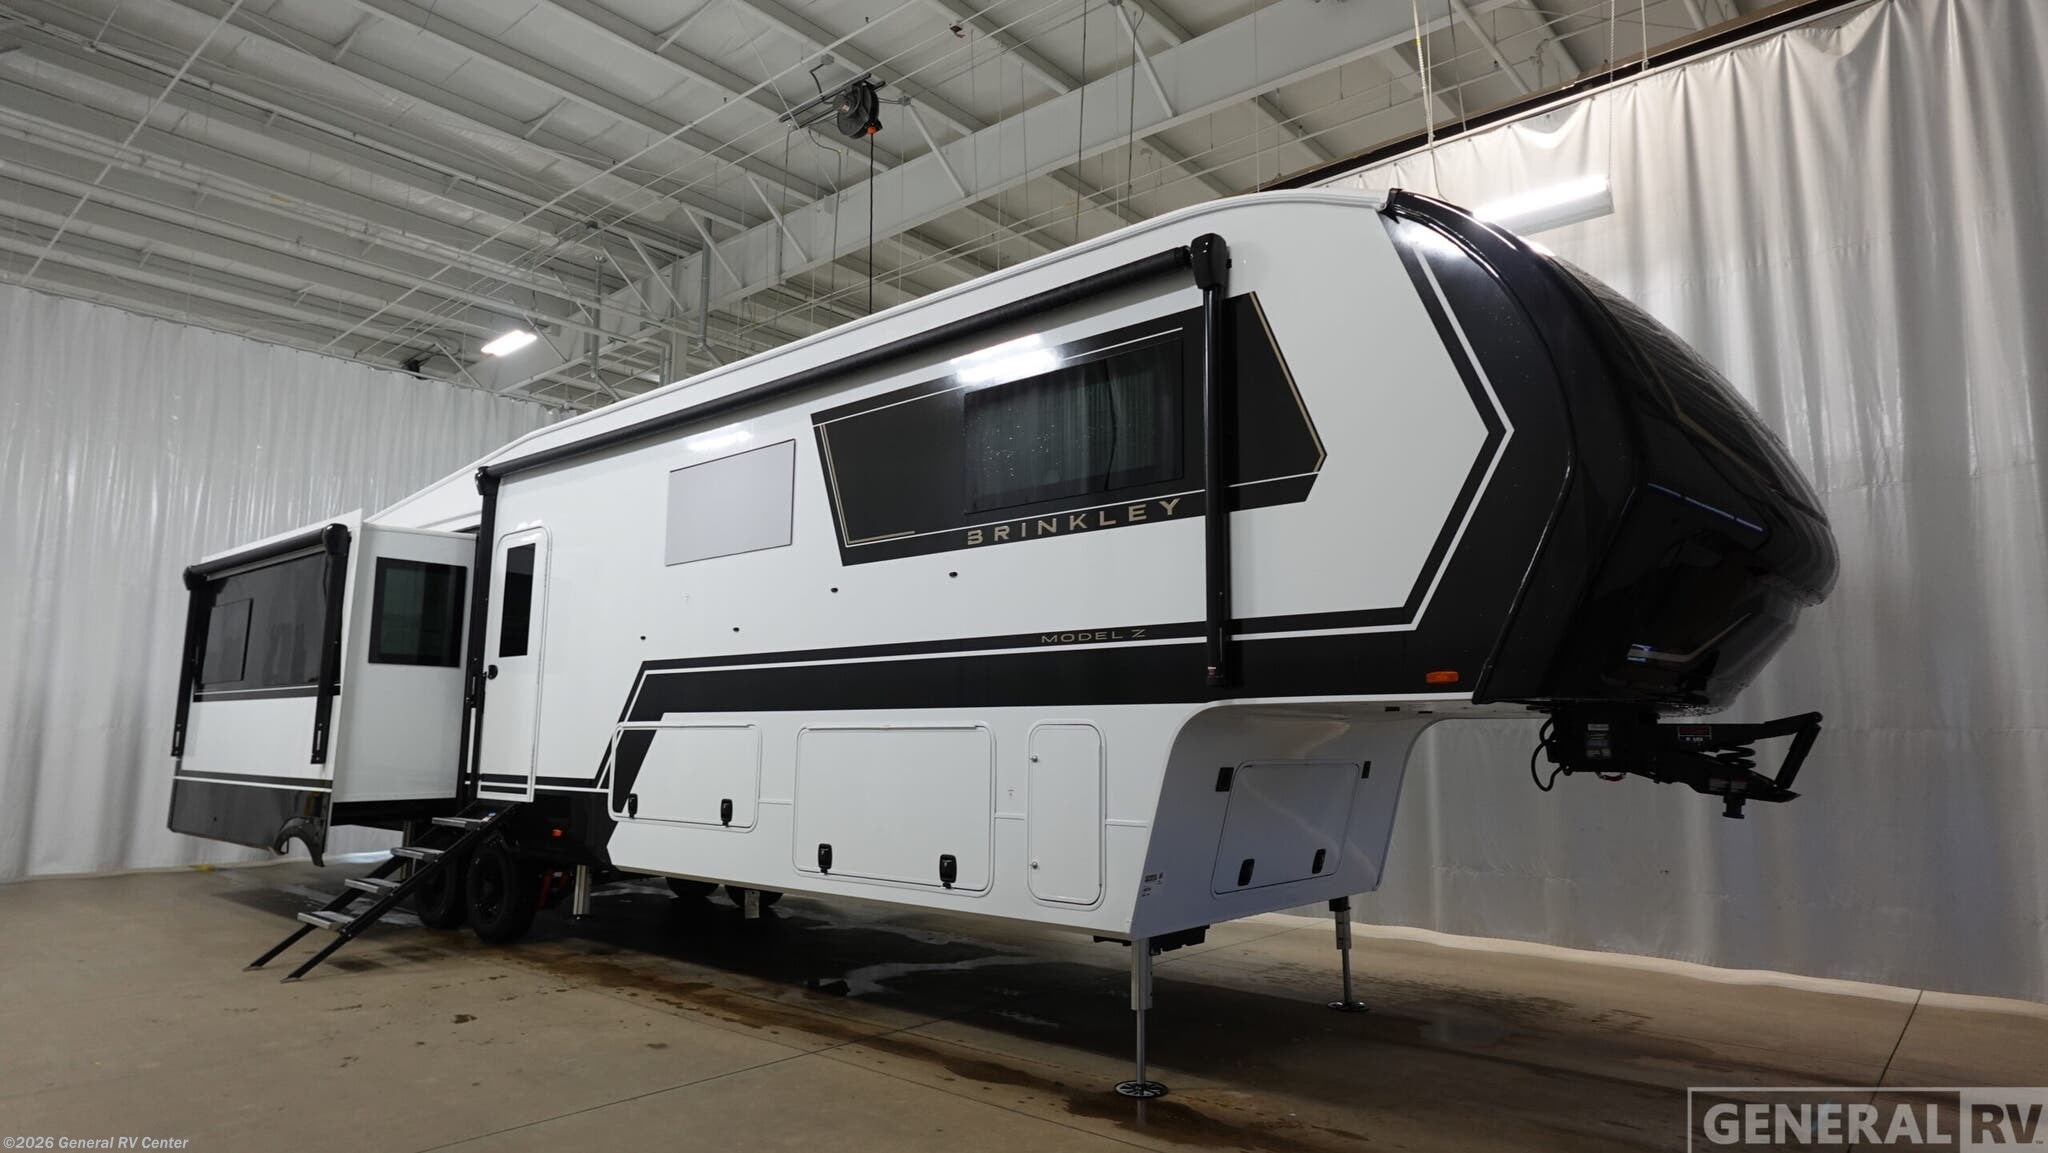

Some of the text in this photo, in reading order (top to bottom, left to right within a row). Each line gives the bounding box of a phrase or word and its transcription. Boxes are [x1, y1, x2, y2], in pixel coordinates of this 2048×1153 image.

[967, 498, 1181, 545] BRINKLEY
[1041, 628, 1146, 643] MODEL Z
